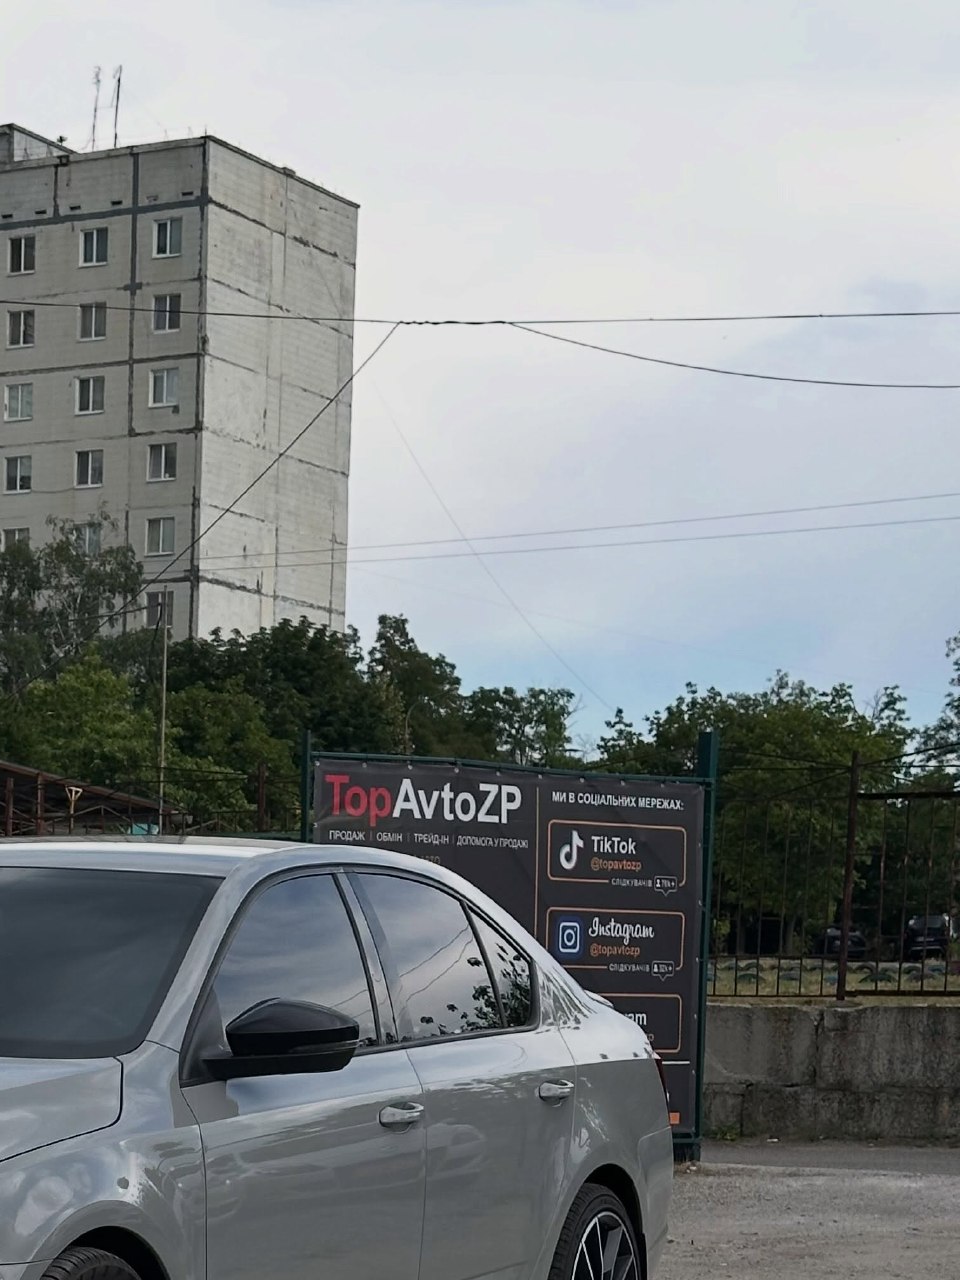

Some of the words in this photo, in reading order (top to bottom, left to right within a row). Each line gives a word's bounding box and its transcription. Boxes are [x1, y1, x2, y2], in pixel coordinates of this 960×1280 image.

[325, 774, 522, 827] TopAvtoZP
[552, 791, 567, 803] МИ
[568, 792, 576, 804] В
[577, 792, 637, 808] СОЦІАЛЬНИХ
[638, 797, 685, 811] МЕРЕЖАХ:
[329, 829, 366, 842] ПРОДАЖ
[376, 831, 403, 843] ОБМІН
[591, 835, 636, 855] TikTok
[591, 857, 642, 873] @topavtozp
[588, 916, 655, 946] Instagram
